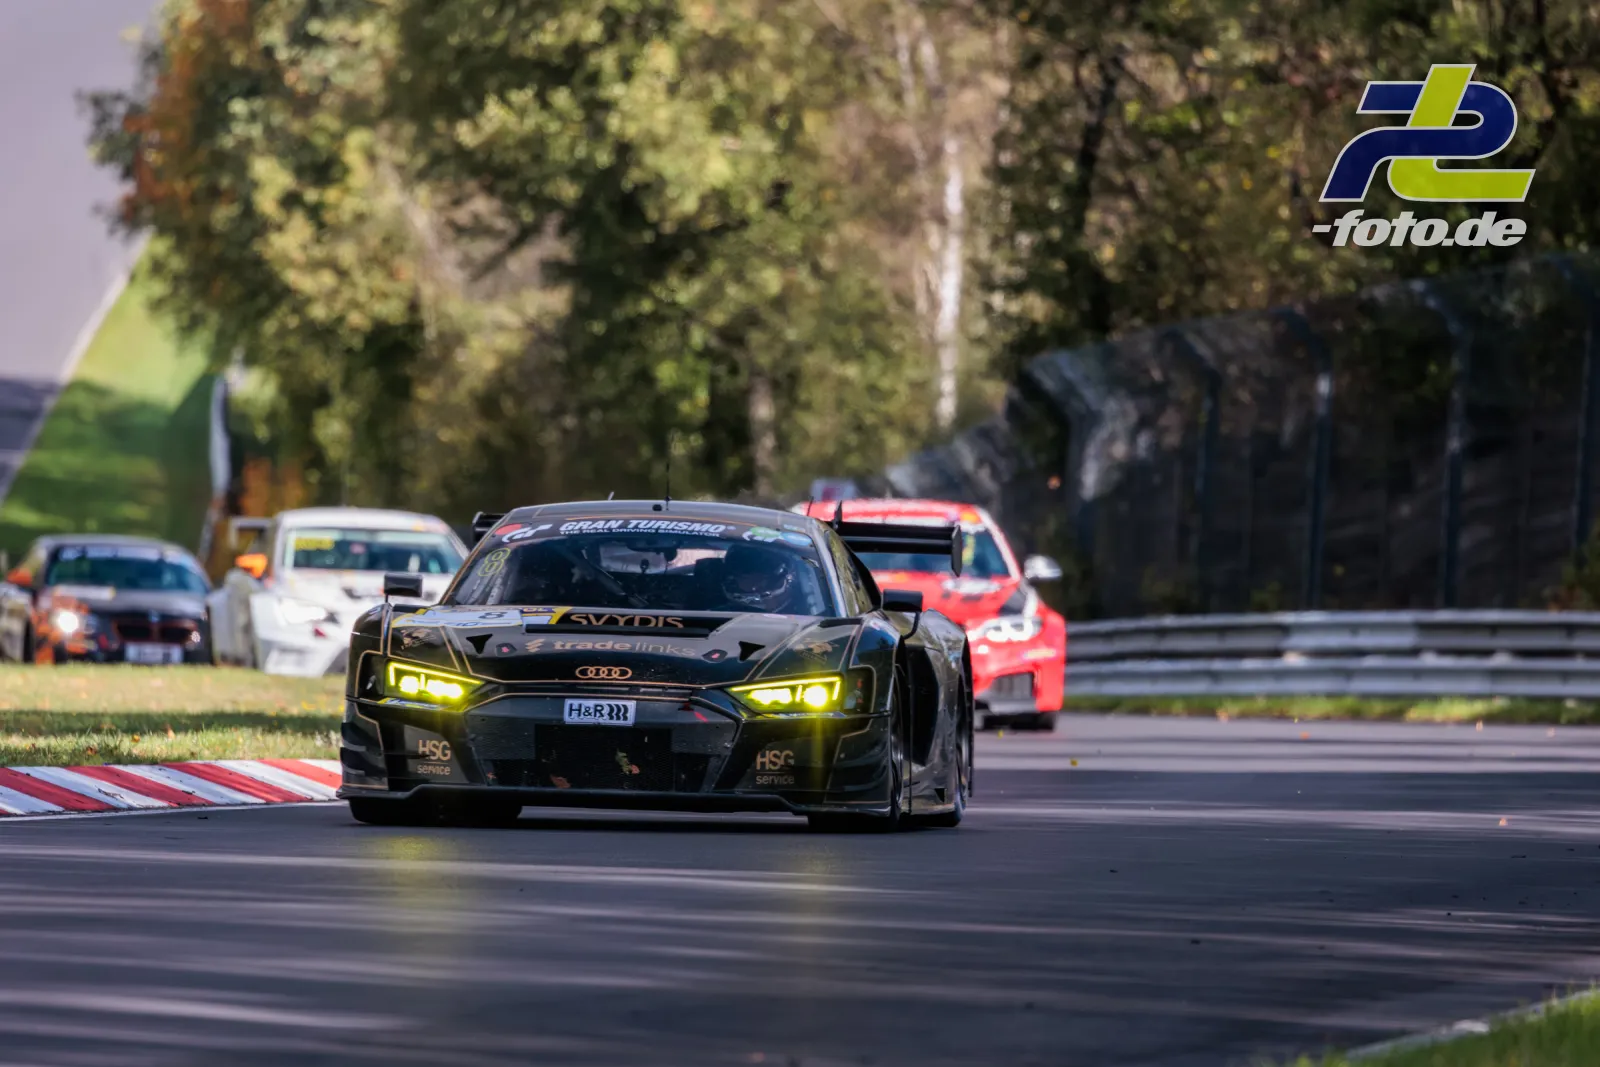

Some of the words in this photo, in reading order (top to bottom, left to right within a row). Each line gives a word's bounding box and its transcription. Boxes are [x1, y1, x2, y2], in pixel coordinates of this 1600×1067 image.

[559, 520, 624, 531] GRAN
[627, 519, 727, 533] TURISMO
[658, 528, 720, 538] SIMULATOR
[568, 703, 605, 718] H&R
[417, 739, 451, 761] HSG
[756, 749, 795, 770] HSG
[416, 763, 451, 776] service
[755, 774, 795, 785] service
